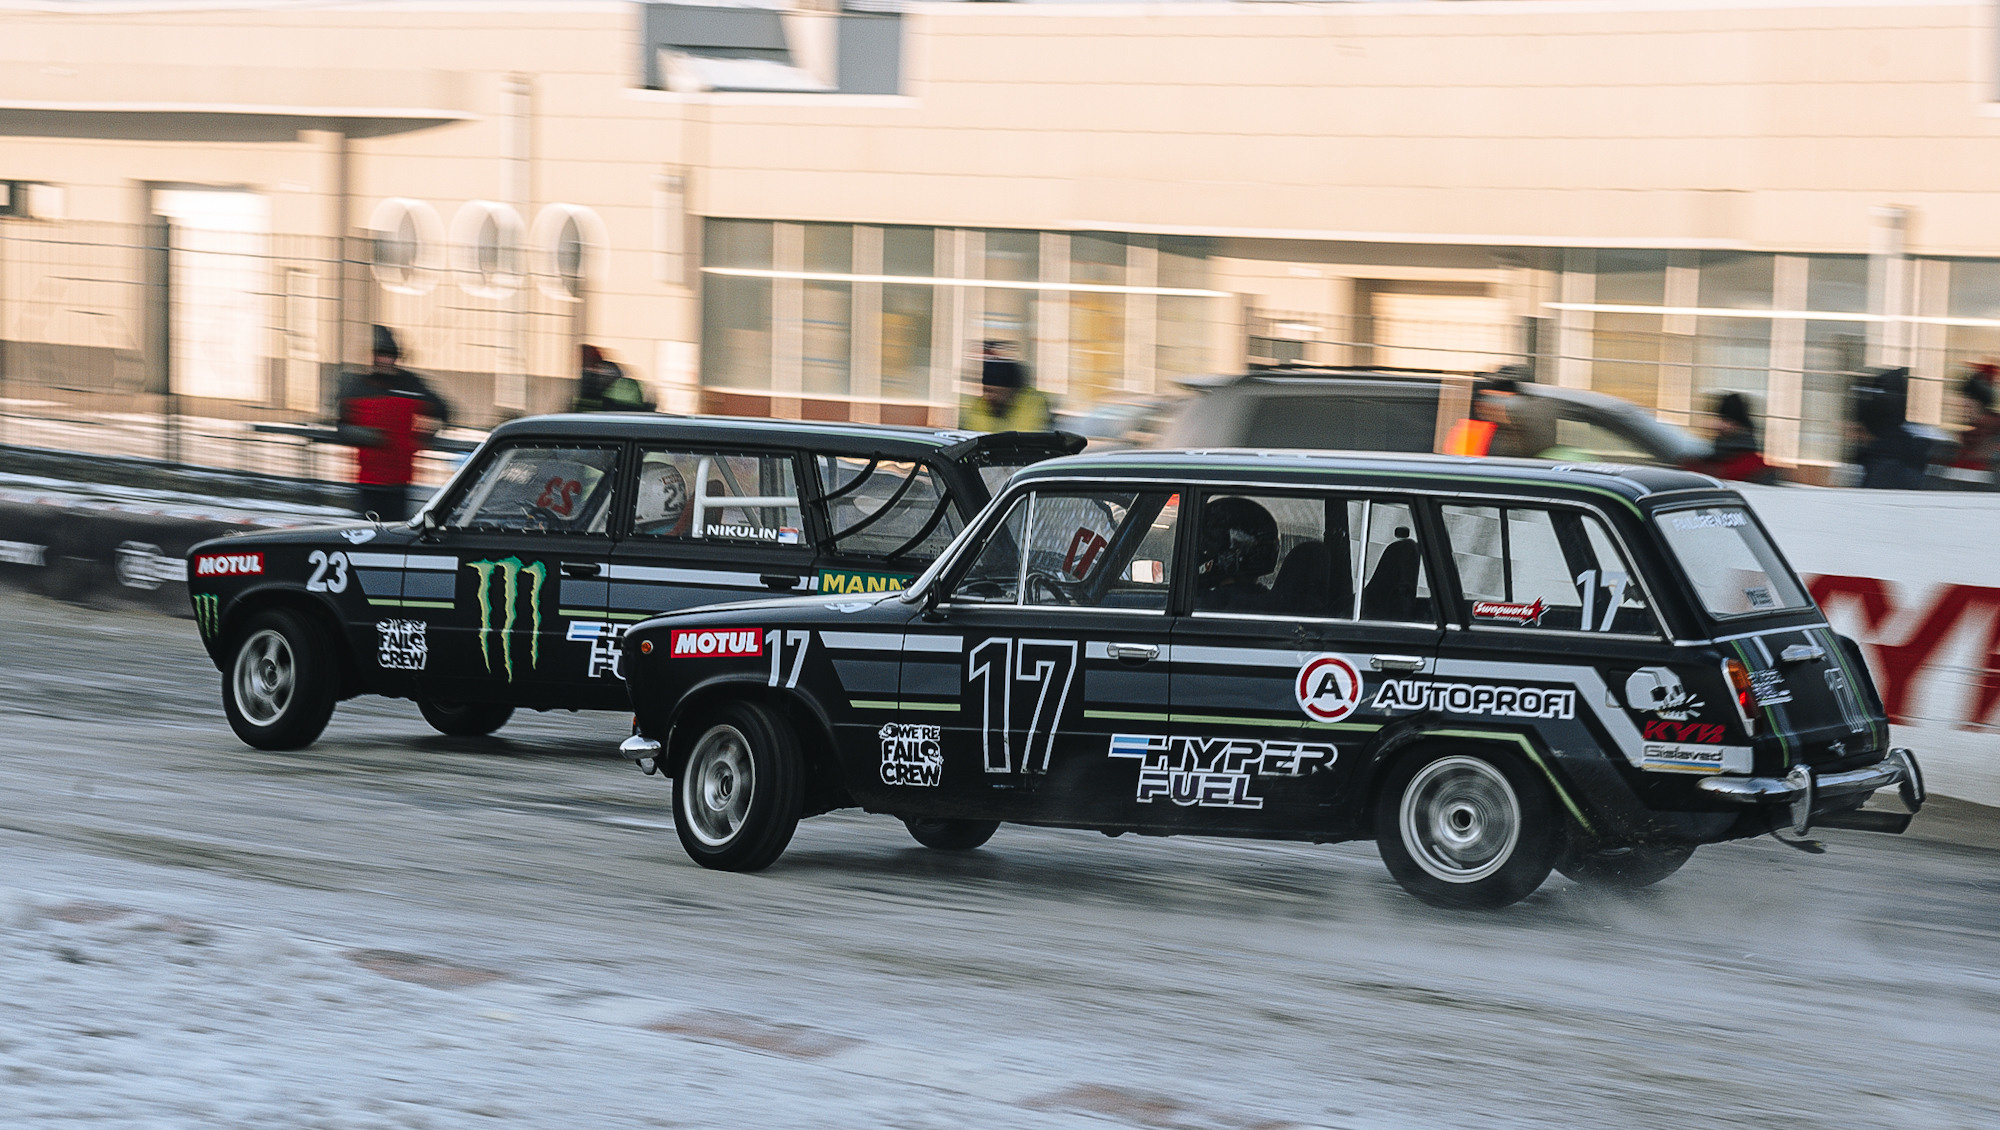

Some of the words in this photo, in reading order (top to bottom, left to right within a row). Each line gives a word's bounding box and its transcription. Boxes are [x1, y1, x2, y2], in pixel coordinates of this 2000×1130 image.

[706, 524, 777, 540] NIKULIN
[198, 555, 262, 575] MOTUL
[306, 550, 348, 593] 23
[1475, 602, 1534, 617] Swapworks
[1576, 569, 1627, 632] 17
[675, 632, 759, 654] MOTUL
[378, 651, 427, 670] CREW
[765, 629, 810, 689] 17
[969, 637, 1078, 775] 17
[1371, 679, 1576, 720] AUTOPROFI
[1642, 720, 1726, 743] KYB
[882, 740, 926, 763] FAIL
[1108, 733, 1338, 776] HYPER
[881, 762, 941, 786] CREW
[1136, 771, 1264, 810] FUEL
